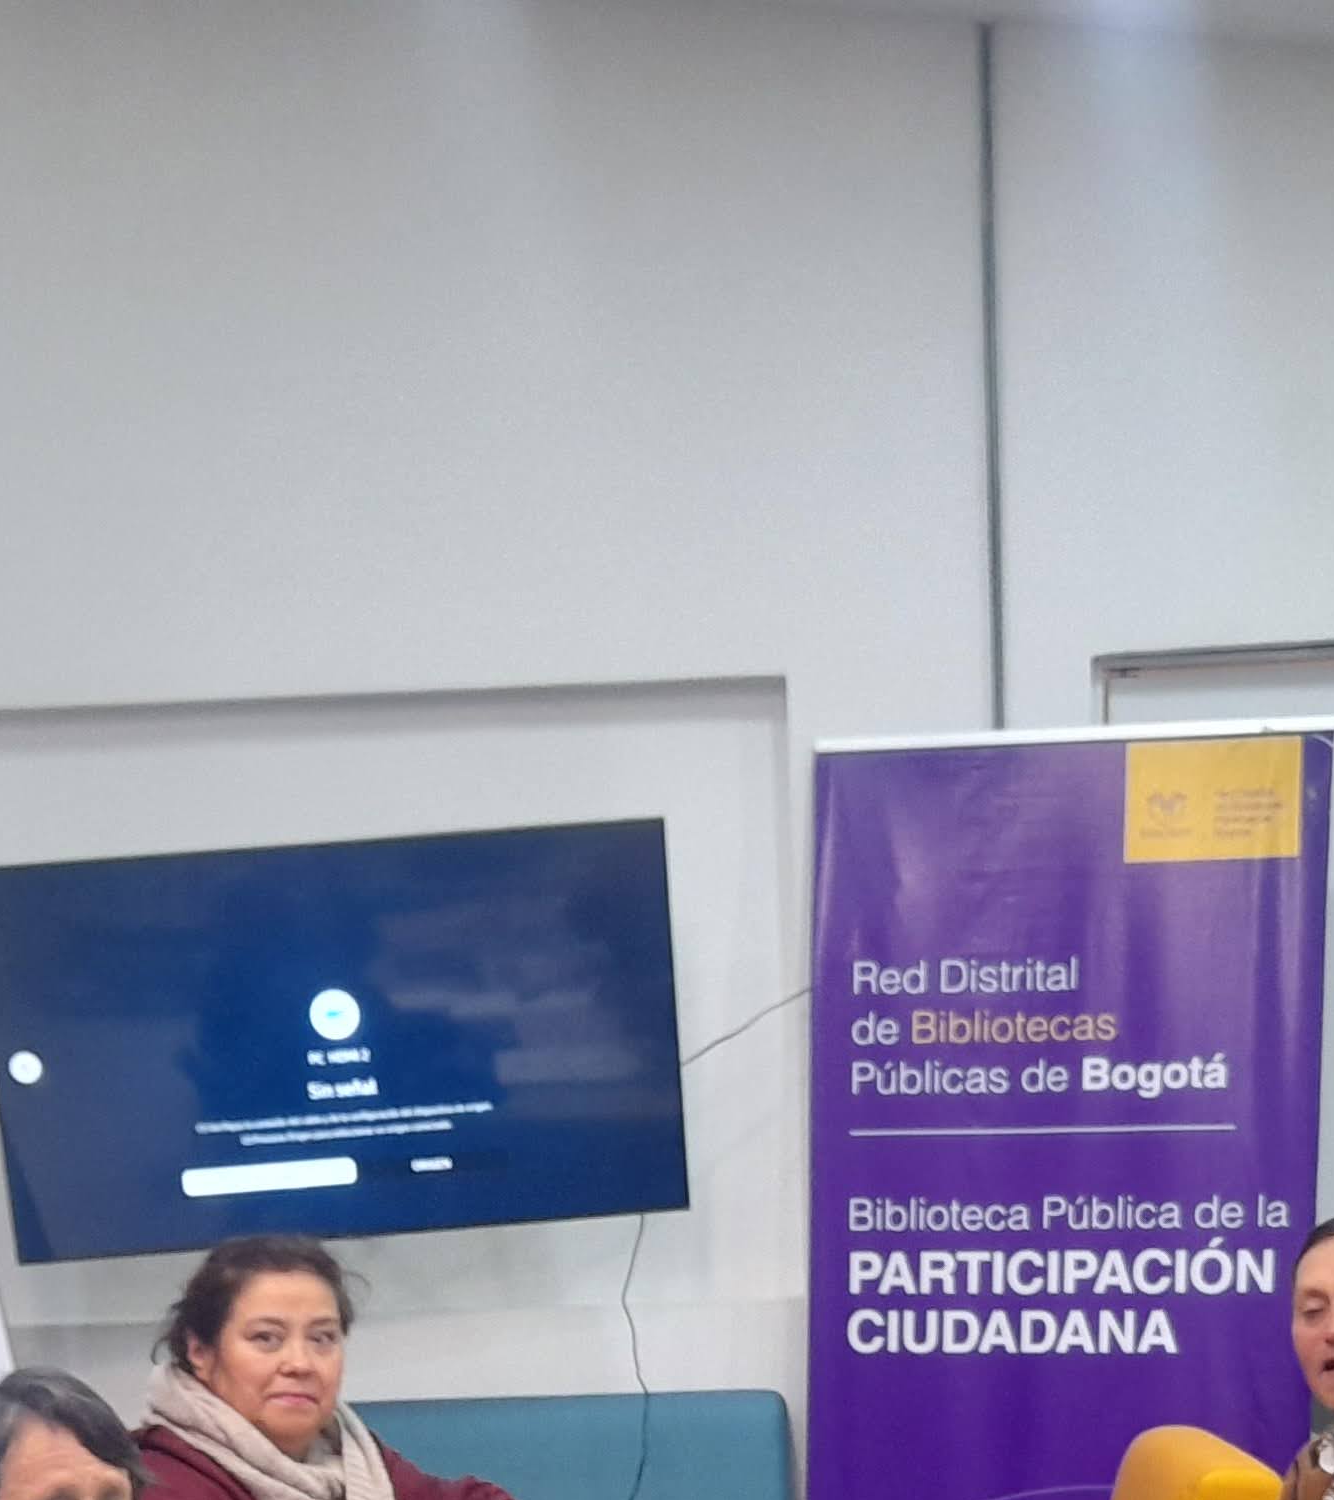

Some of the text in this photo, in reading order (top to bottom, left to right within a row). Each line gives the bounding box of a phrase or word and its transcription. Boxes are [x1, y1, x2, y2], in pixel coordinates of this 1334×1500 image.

[852, 956, 1079, 995] Red Distrital
[851, 1009, 1117, 1046] de Bibliotecas
[851, 1053, 1229, 1099] Públicas de Bogotá
[849, 1194, 1291, 1232] Biblioteca Pública de la
[848, 1237, 1276, 1295] PARTICIPACIÓN
[846, 1308, 1179, 1354] CIUDADANA
